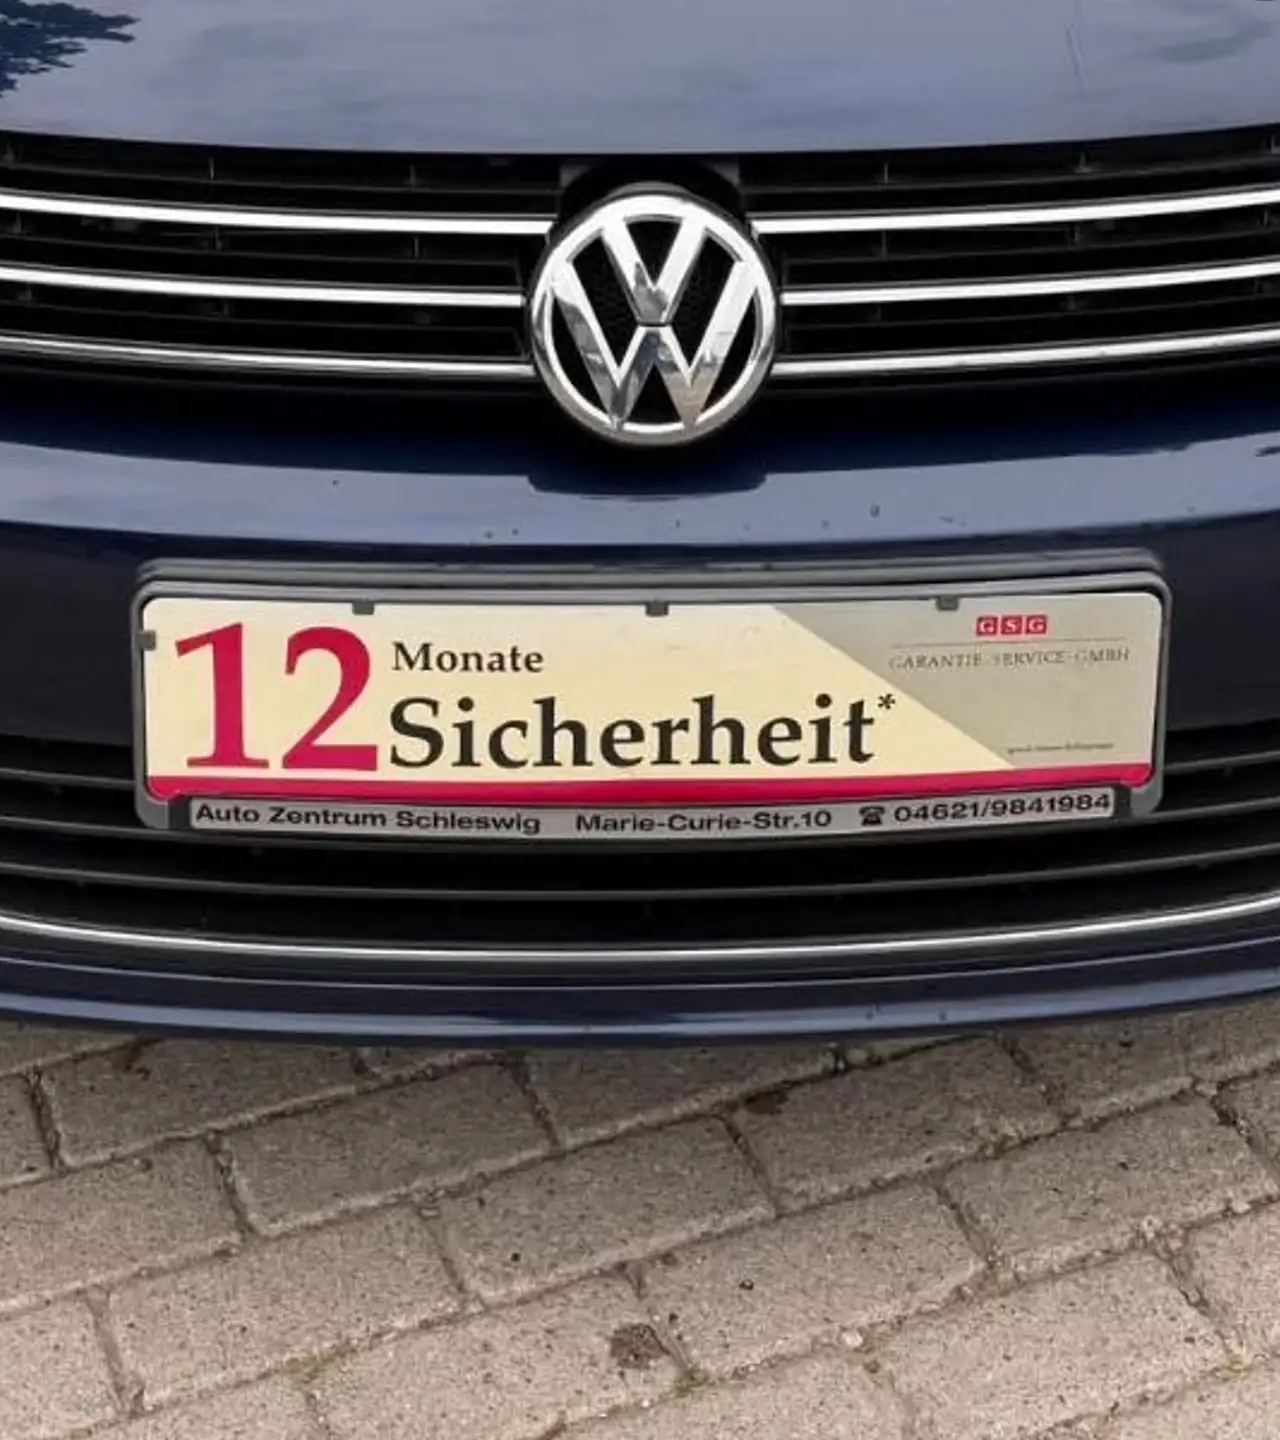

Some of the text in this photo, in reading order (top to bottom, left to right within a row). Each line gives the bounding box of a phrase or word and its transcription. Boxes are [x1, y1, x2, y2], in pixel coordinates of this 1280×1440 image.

[977, 615, 1048, 636] GSG
[391, 641, 544, 674] Monate
[175, 622, 378, 771] 12
[195, 792, 1111, 835] Auto Zentrum Schleswig Marie-Curie-Str.10 04621/9841984
